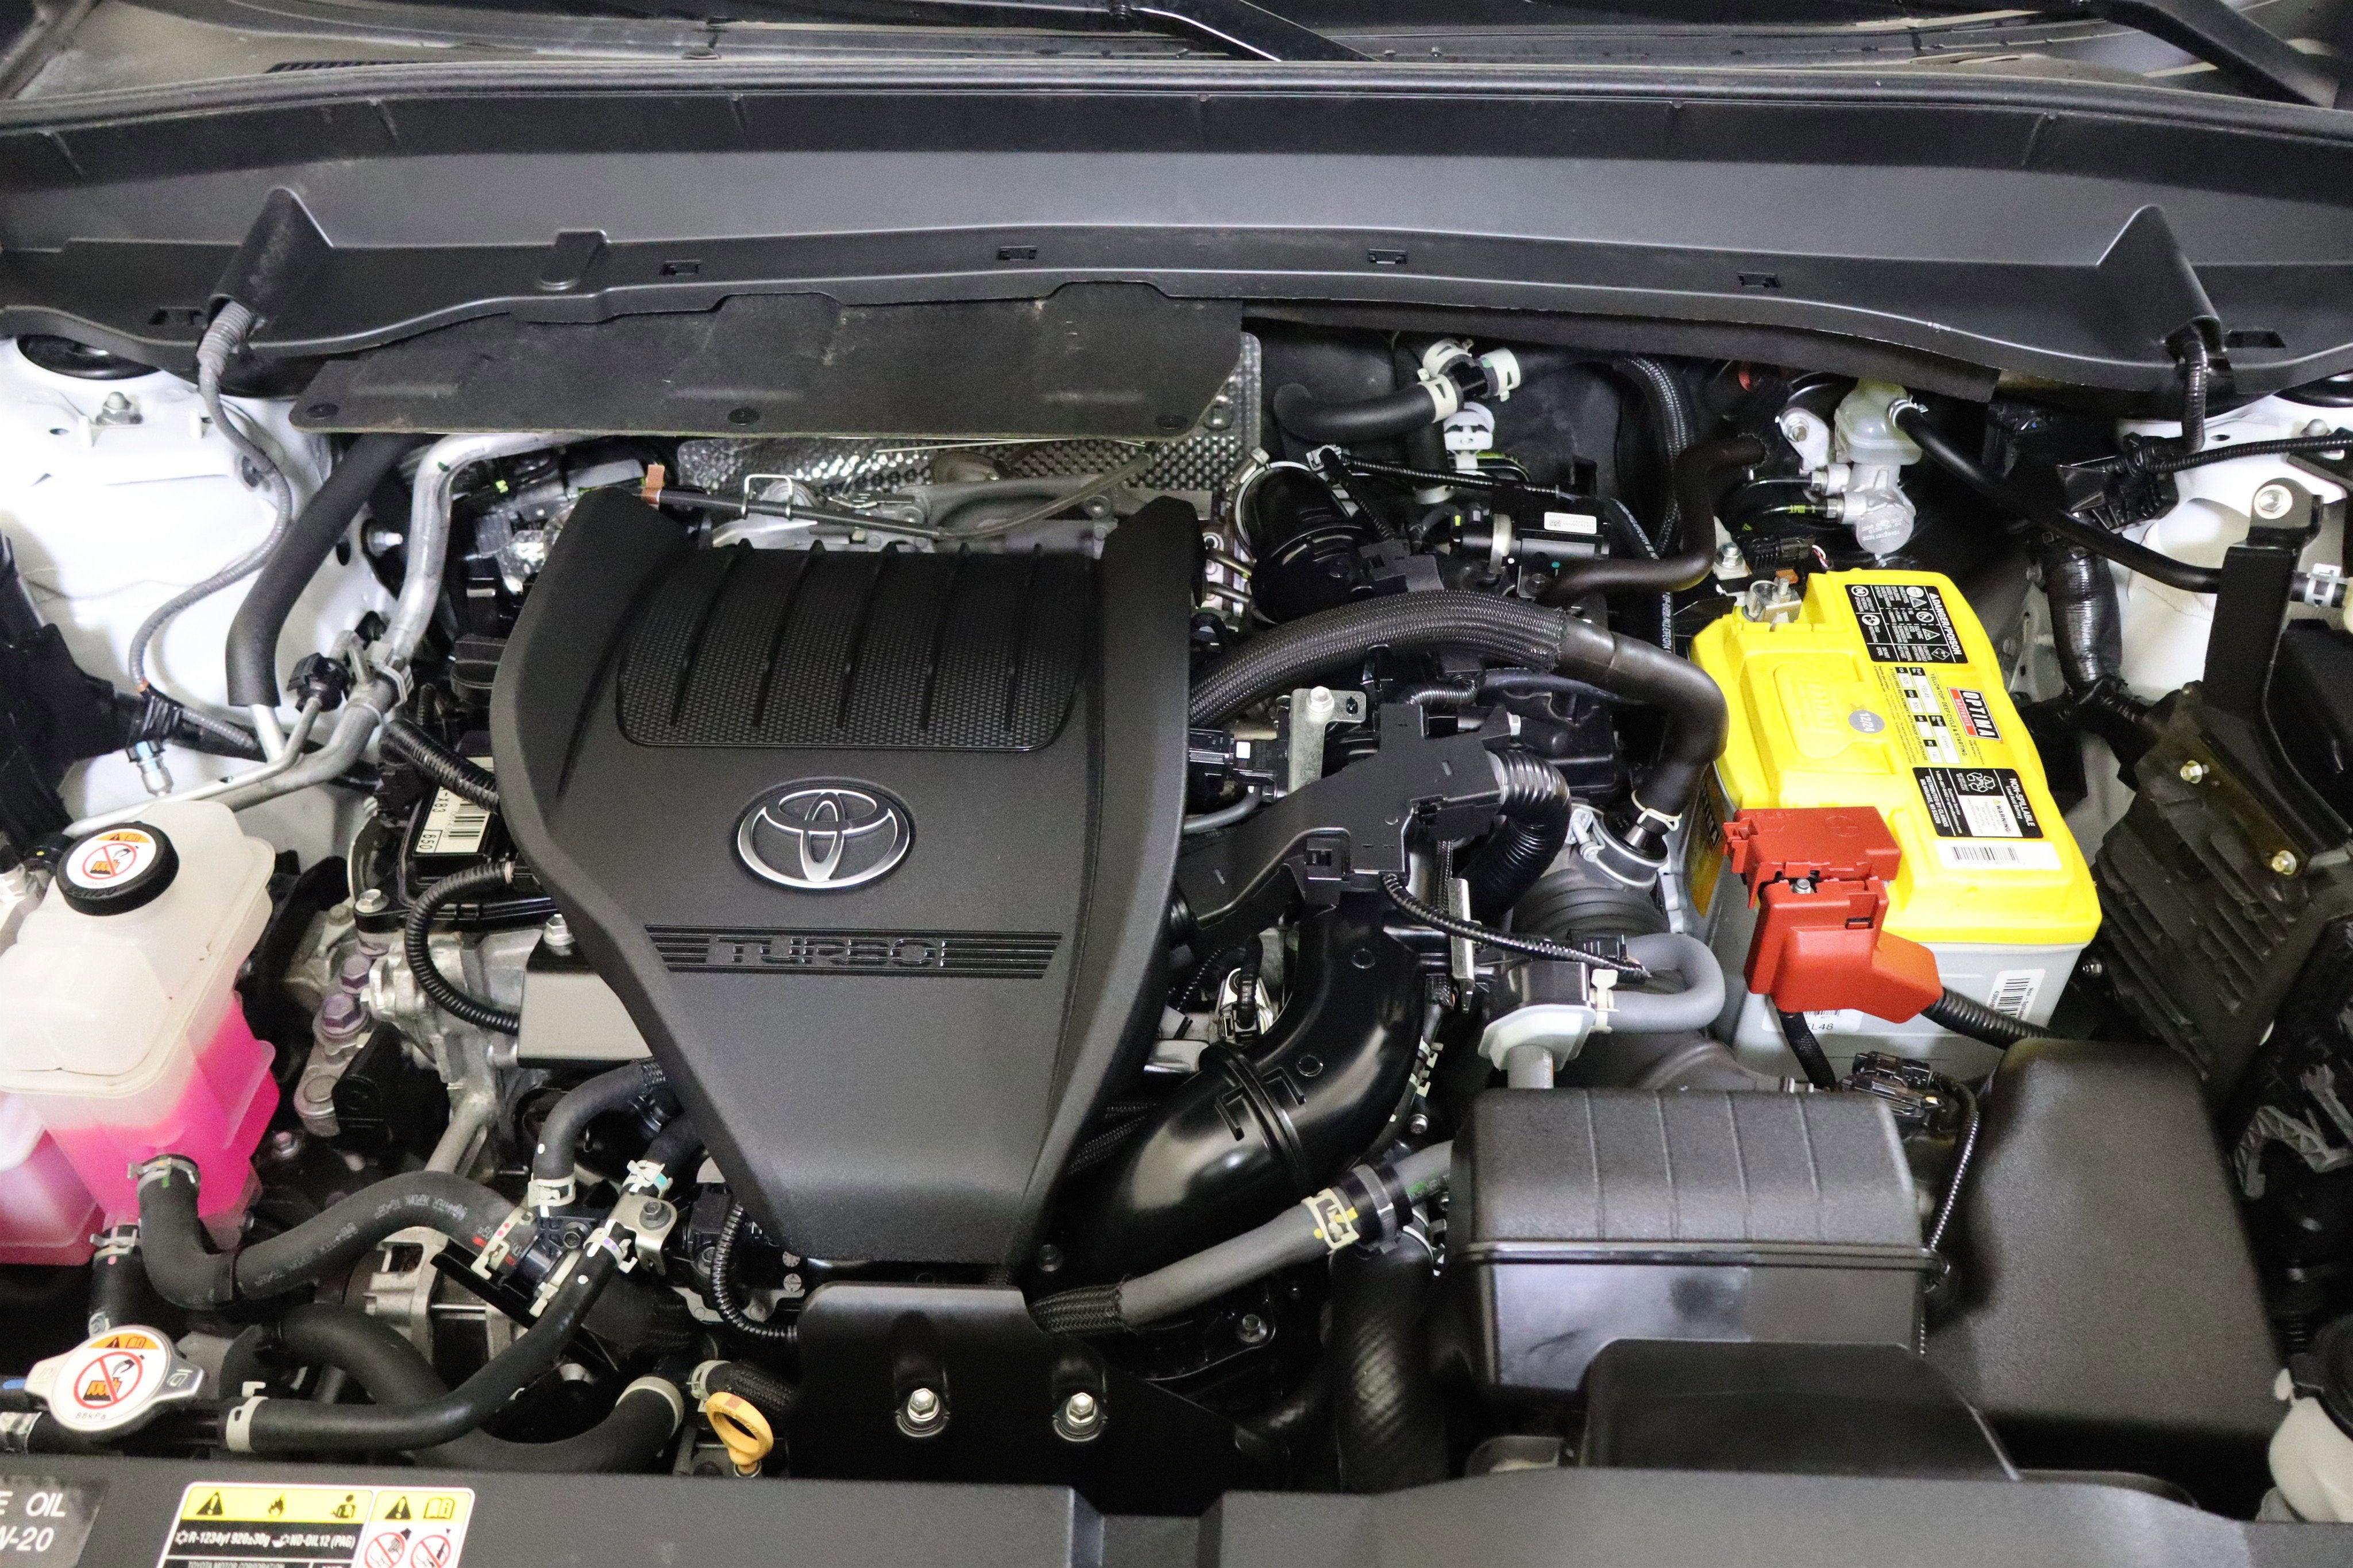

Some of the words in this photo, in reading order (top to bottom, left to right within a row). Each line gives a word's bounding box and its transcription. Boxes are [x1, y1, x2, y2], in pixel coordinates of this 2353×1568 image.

[1931, 599, 1962, 655] DANGER/POISON
[1859, 712, 1876, 732] 12/24
[1896, 689, 1911, 715] REPLACEMENT
[1906, 714, 1914, 724] WITH
[1910, 723, 1919, 735] PROOF
[1954, 698, 1972, 727] BATTERIES
[1961, 691, 1996, 737] OPTIMA
[1940, 701, 1950, 713] DEEP
[1945, 713, 1956, 728] CYCLE
[1953, 732, 1968, 756] STARTING
[1924, 775, 1941, 802] DISTRIBUTED
[1937, 808, 1951, 827] CLARIOS
[2004, 785, 2014, 795] Lead
[2008, 795, 2018, 804] Acid
[2008, 778, 2036, 827] NON-SPILLABLE
[1931, 809, 1943, 824] 53209
[2011, 804, 2024, 820] Battery
[419, 834, 437, 849] 650
[716, 934, 937, 967] TURBO
[75, 1411, 107, 1420] 88kPa
[26, 1492, 66, 1517] OIL
[330, 1534, 356, 1550] (PAG)
